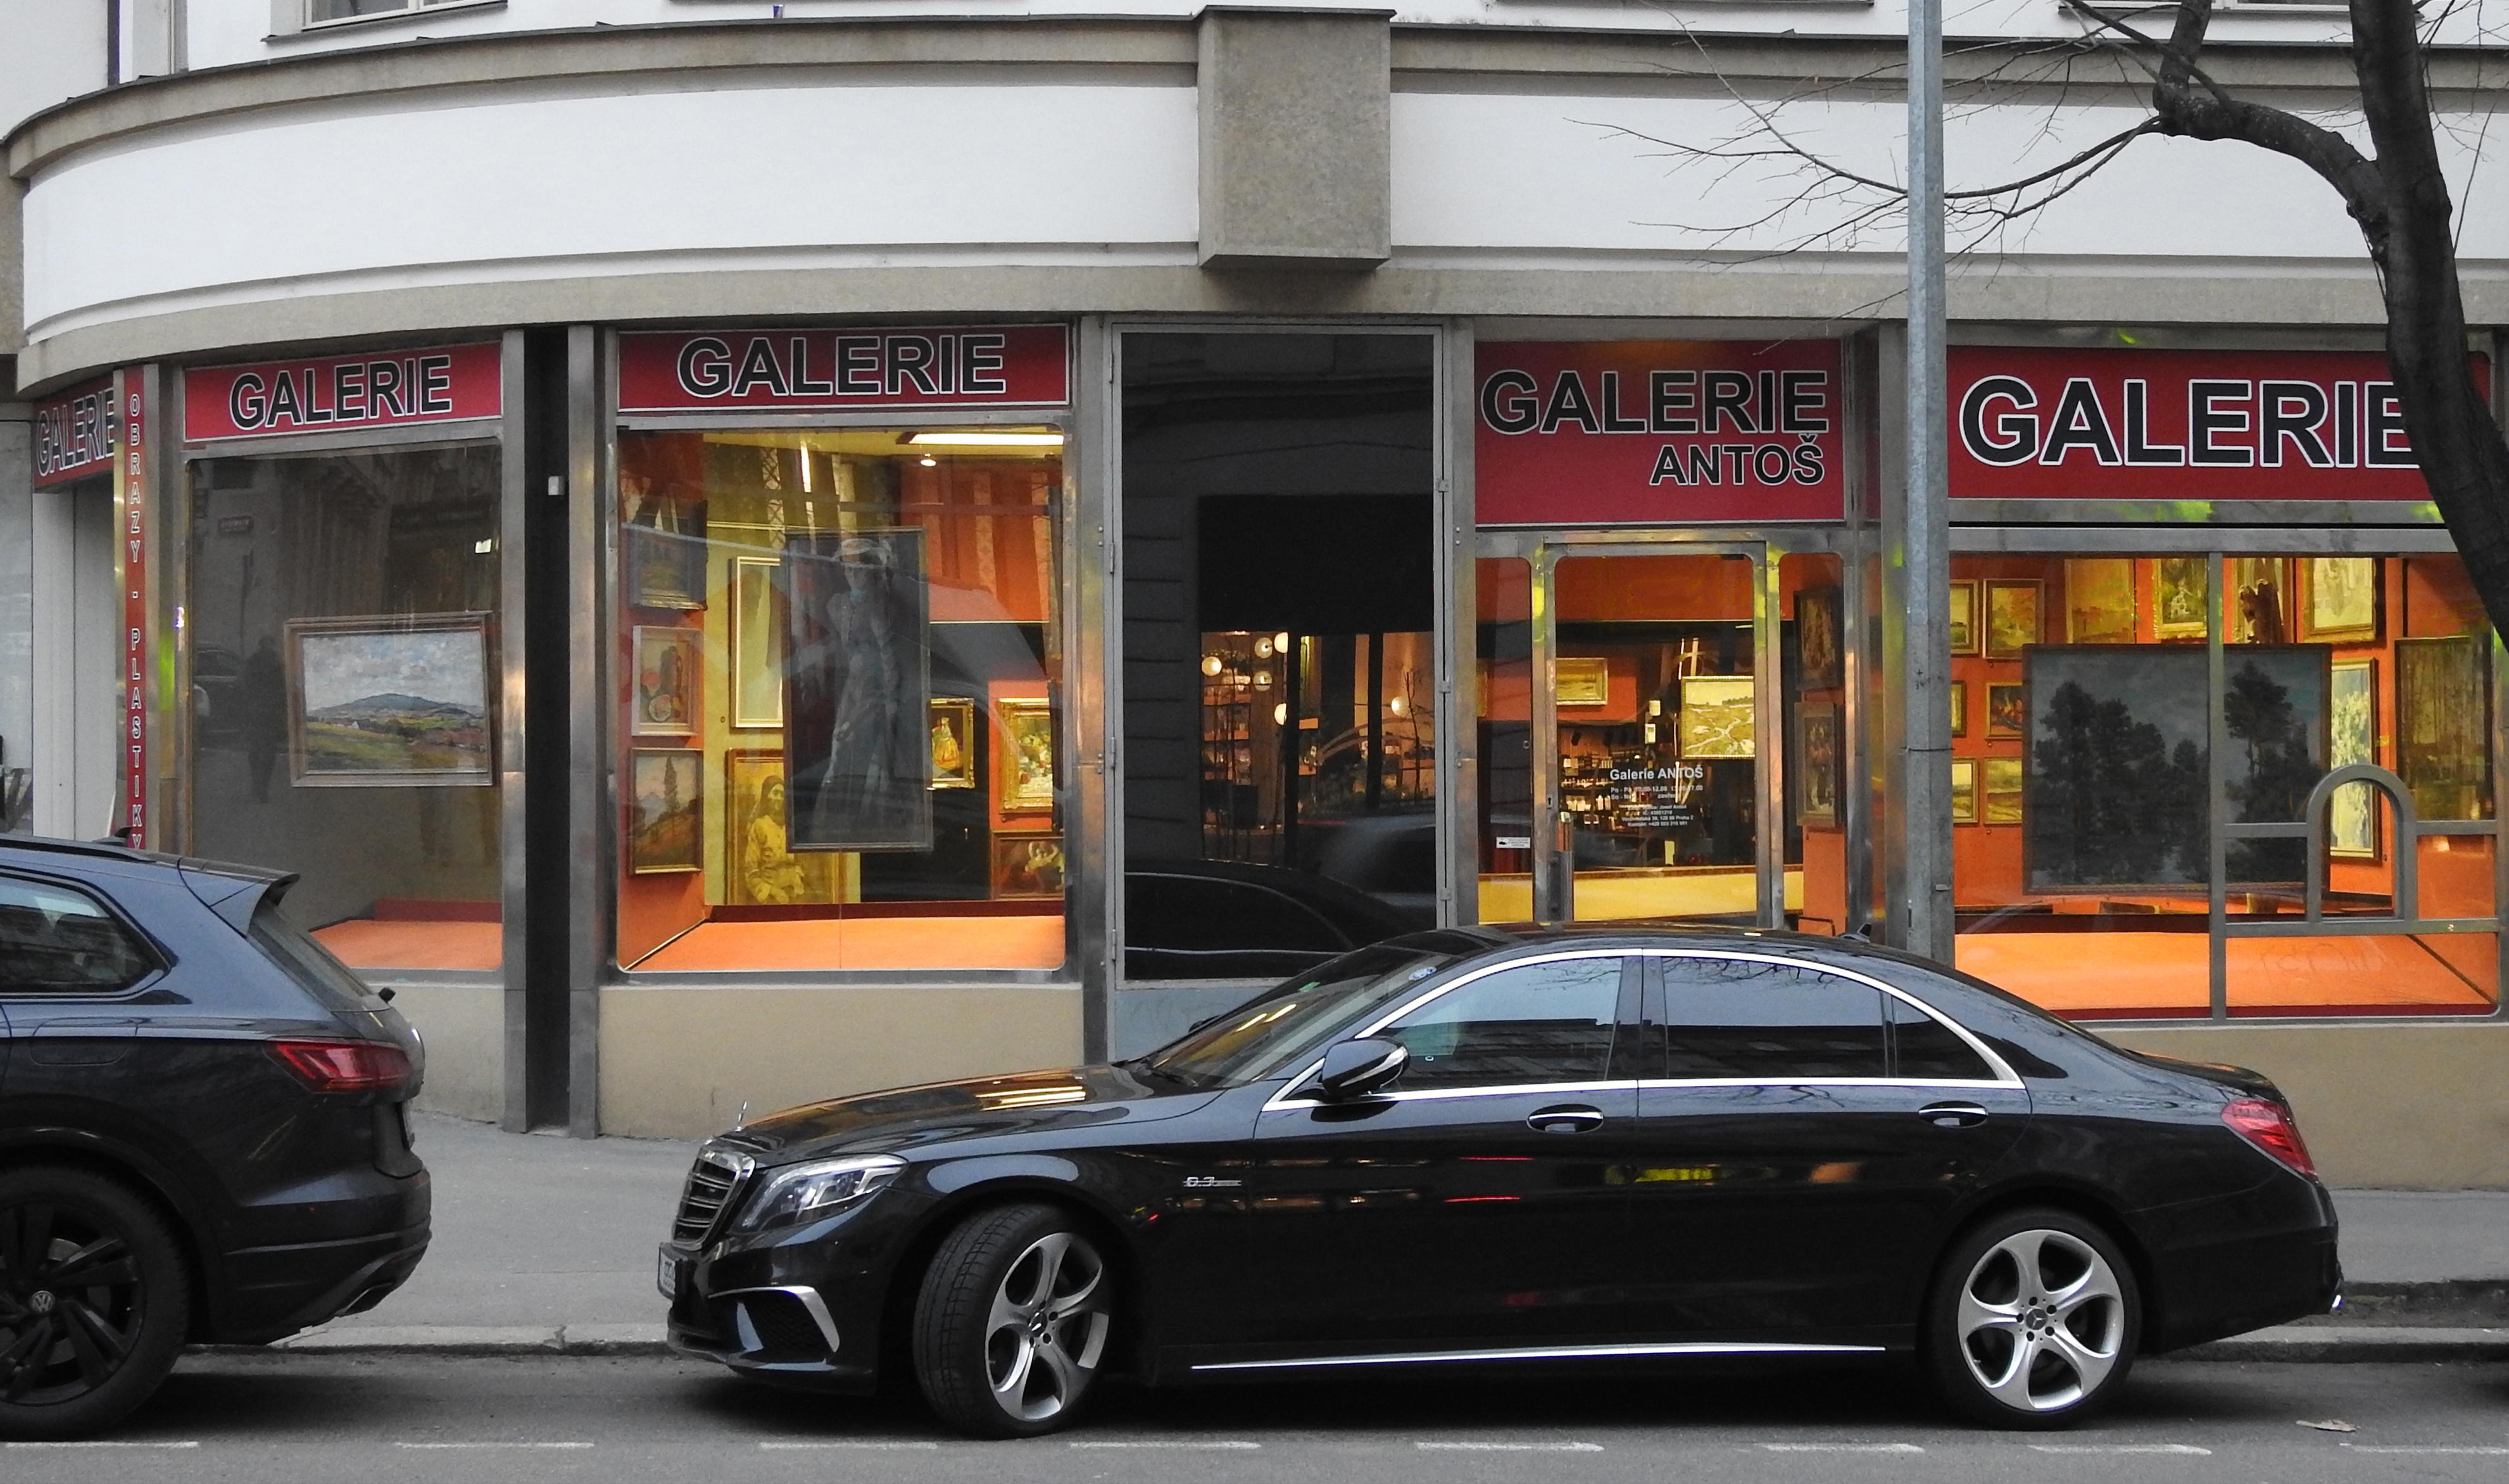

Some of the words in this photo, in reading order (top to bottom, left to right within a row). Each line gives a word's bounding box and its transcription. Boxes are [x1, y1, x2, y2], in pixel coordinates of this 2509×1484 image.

[229, 355, 452, 431] GALERIE
[677, 334, 1007, 398] GALERIE
[36, 387, 115, 476] GALERIE
[1480, 369, 1828, 434] GALERIE
[1959, 375, 2420, 468] GALERIE
[129, 393, 141, 563] OBRAZY
[1649, 432, 1825, 486] ANTOŠ
[1610, 768, 1654, 780] Galerie
[1657, 764, 1703, 779] ANTOŠ
